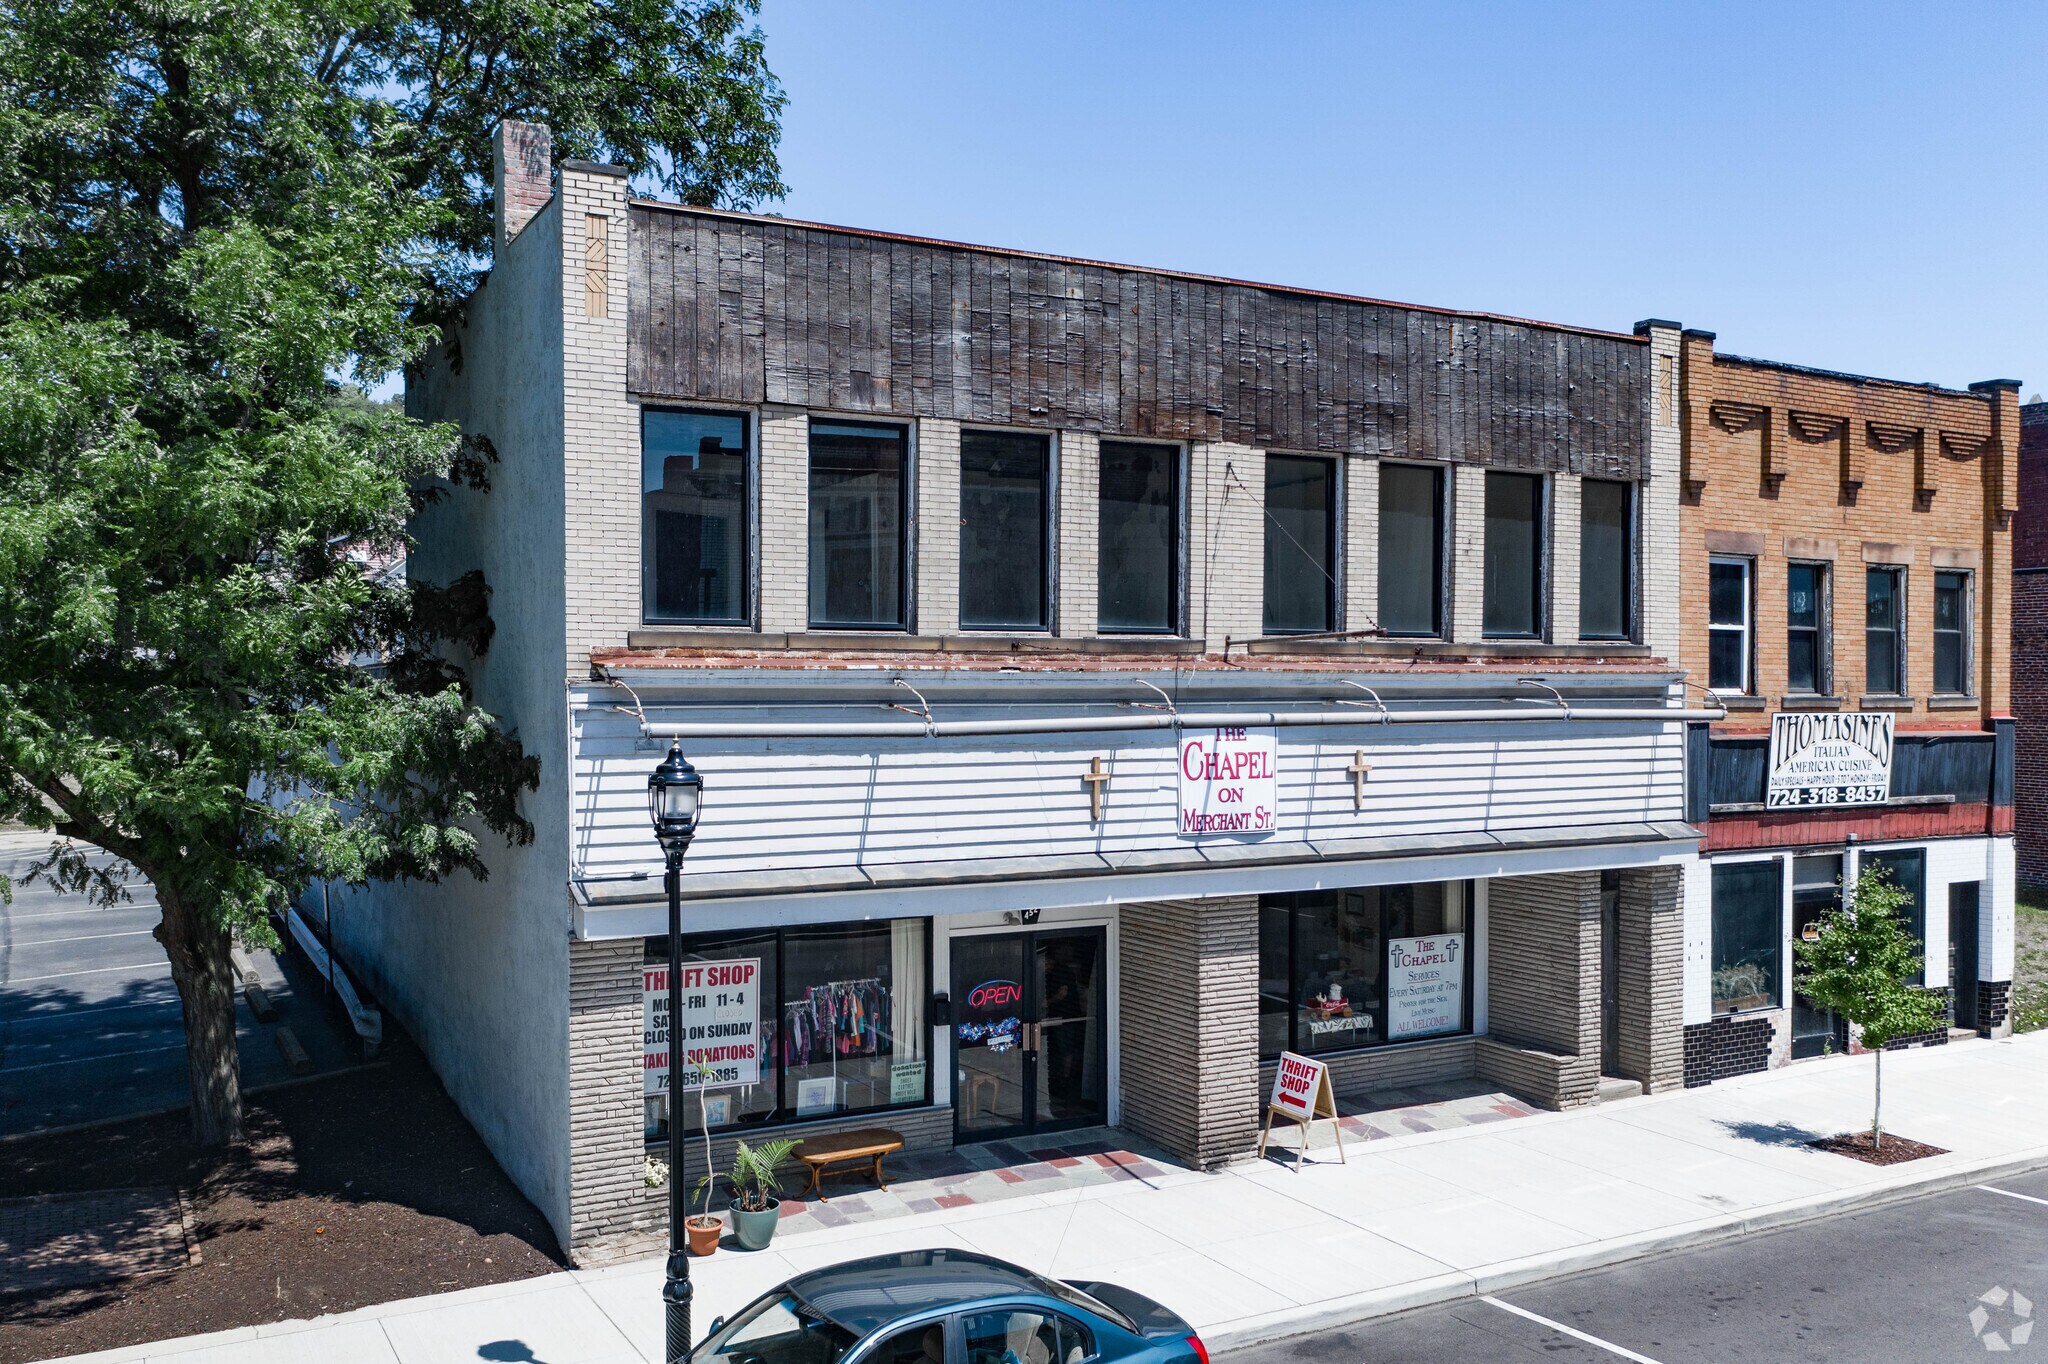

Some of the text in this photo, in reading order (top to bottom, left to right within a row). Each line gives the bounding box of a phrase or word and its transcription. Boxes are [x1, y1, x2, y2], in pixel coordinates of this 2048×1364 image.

[1775, 714, 1890, 772] THOMASINES
[1814, 746, 1850, 757] ITALIAN
[1183, 741, 1273, 781] CHAPEL
[1788, 760, 1872, 773] AMERICAN CUISINE
[1218, 787, 1244, 803] ON
[1770, 785, 1887, 806] 724-318-8437
[1182, 805, 1273, 832] MERCHANT ST.
[1415, 940, 1435, 952] THE
[1402, 954, 1446, 967] CHAPEL
[643, 965, 754, 992] THIFT SHOP
[1408, 971, 1440, 981] SERVICES
[689, 995, 706, 1009] FRI
[717, 993, 727, 1006] 11
[737, 992, 744, 1005] 4
[971, 985, 1022, 1006] OPEN
[1389, 987, 1408, 998] EVERY
[644, 1022, 752, 1044] CLOSD ON SUNDAY
[1397, 1021, 1411, 1032] ALL
[688, 1044, 754, 1065] DONATIONS
[896, 1069, 921, 1077] wanted
[1281, 1057, 1318, 1081] THRIFT
[1281, 1074, 1310, 1094] SHOP
